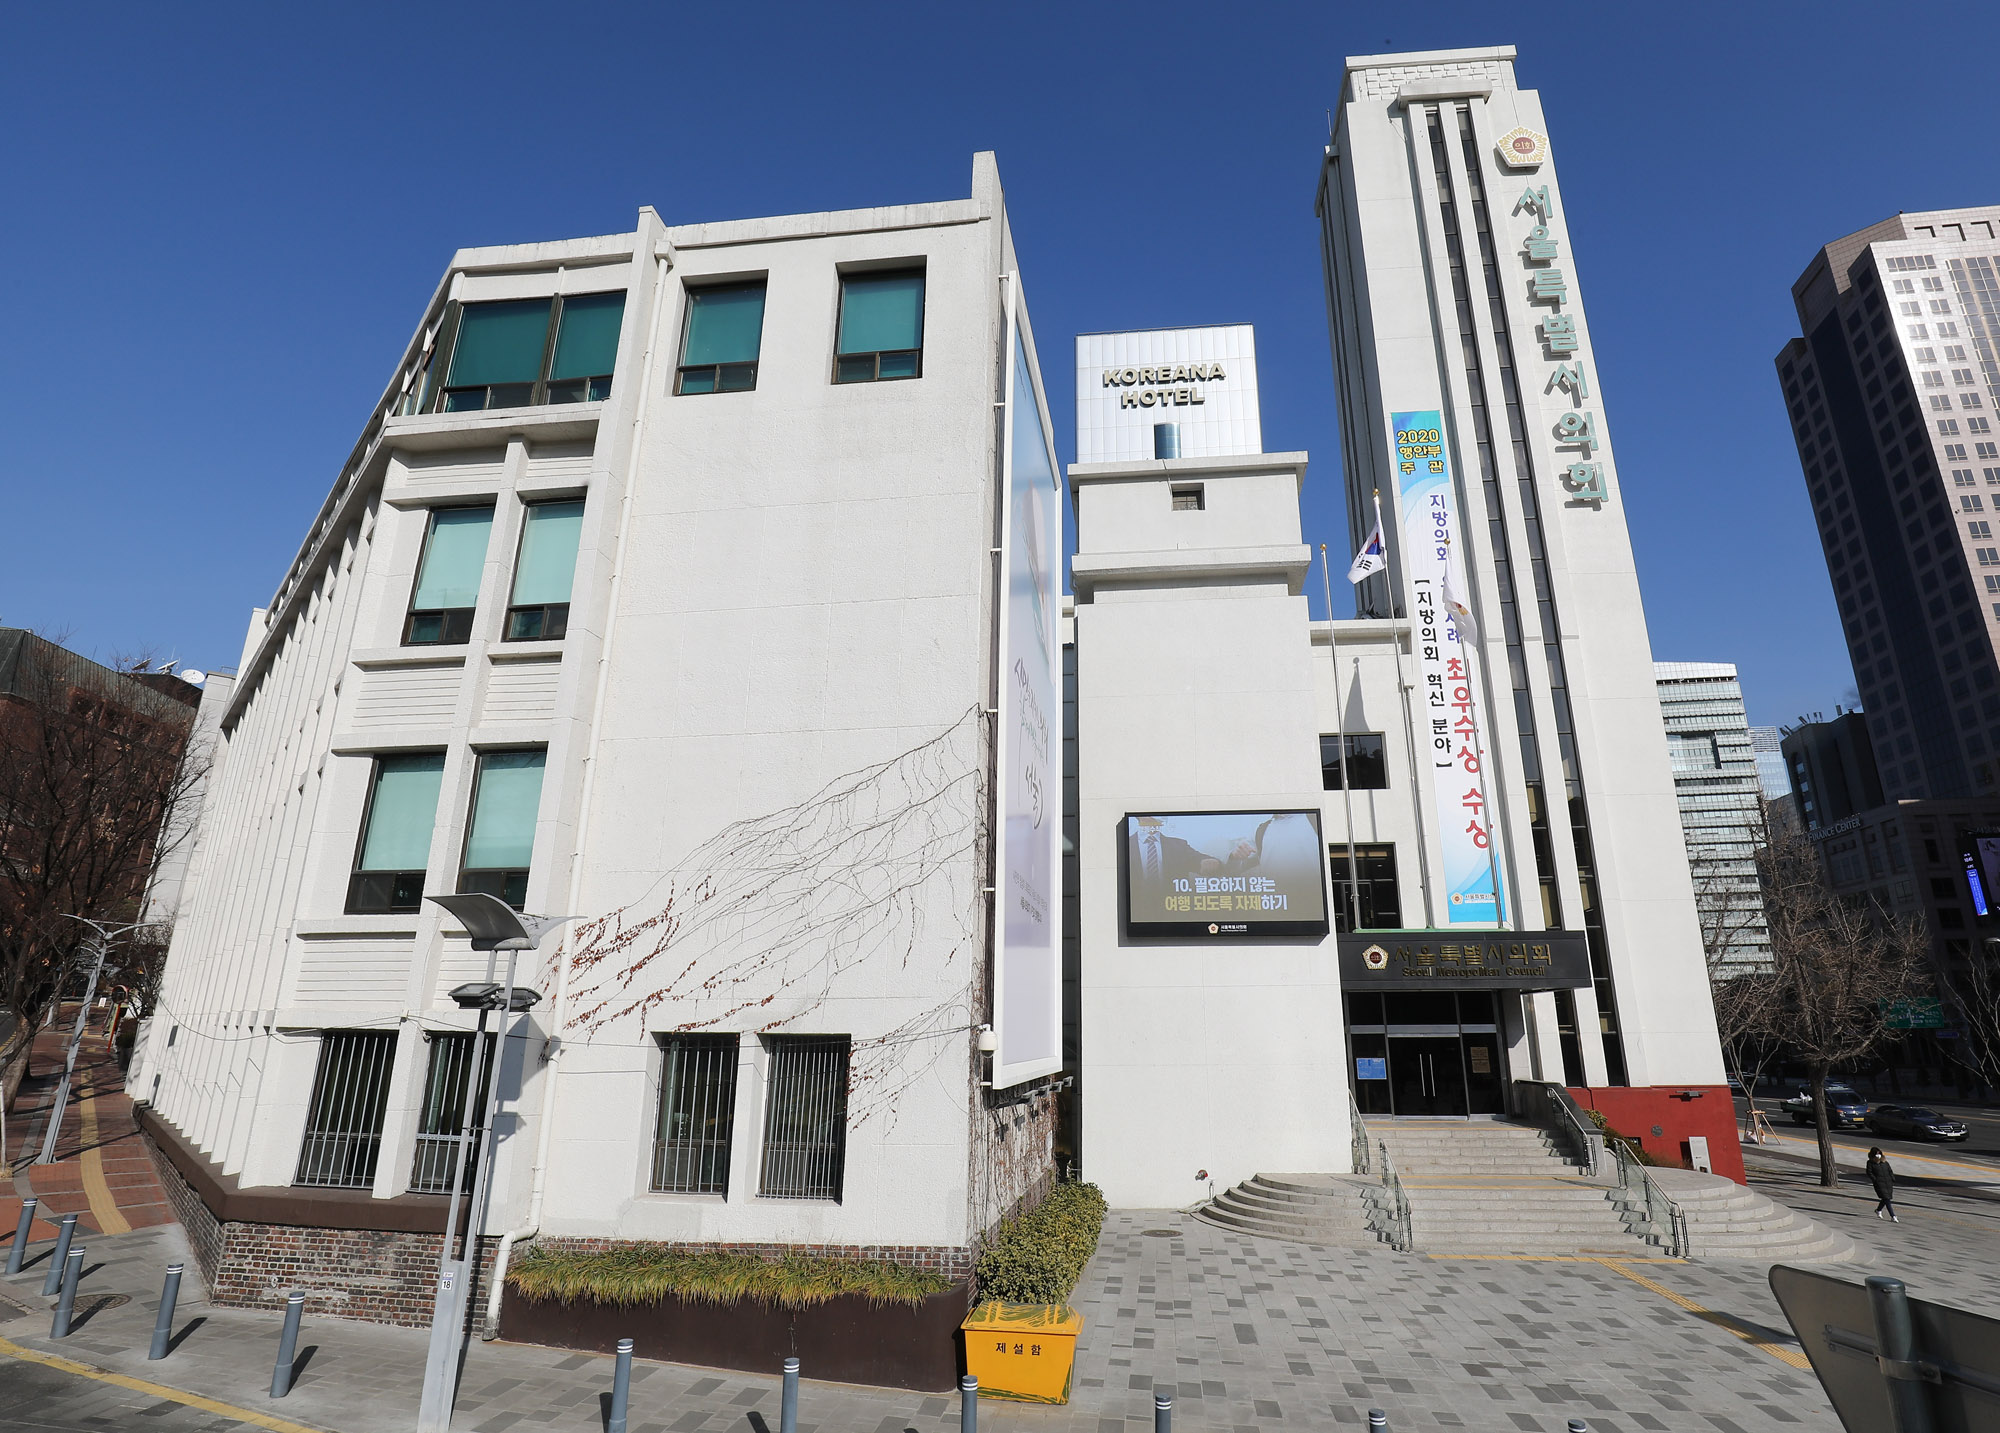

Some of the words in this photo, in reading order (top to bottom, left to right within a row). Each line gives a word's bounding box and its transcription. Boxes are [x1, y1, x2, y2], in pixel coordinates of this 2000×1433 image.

[1514, 141, 1534, 150] 의회
[1517, 184, 1610, 502] 서울특별시의회
[1103, 363, 1226, 387] KOREANA
[1121, 387, 1205, 409] HOTEL
[1397, 428, 1440, 444] 2020
[1399, 445, 1442, 460] 행안부
[1427, 673, 1445, 707] 혁신
[1447, 657, 1484, 774] 최우수상
[1462, 787, 1494, 849] 수상
[1808, 826, 1835, 842] FINANCE
[1172, 878, 1192, 893] 10.
[1194, 877, 1246, 893] 필요하지
[1249, 877, 1276, 893] 않는
[1165, 895, 1190, 911] 여행
[1194, 895, 1233, 911] 되도록
[1235, 894, 1288, 911] 자제하기
[1395, 943, 1552, 966] 서울특별시의회
[1402, 967, 1433, 977] Seoul
[1436, 966, 1500, 978] Metropolitan
[1506, 965, 1545, 976] Council
[443, 1281, 451, 1289] 18
